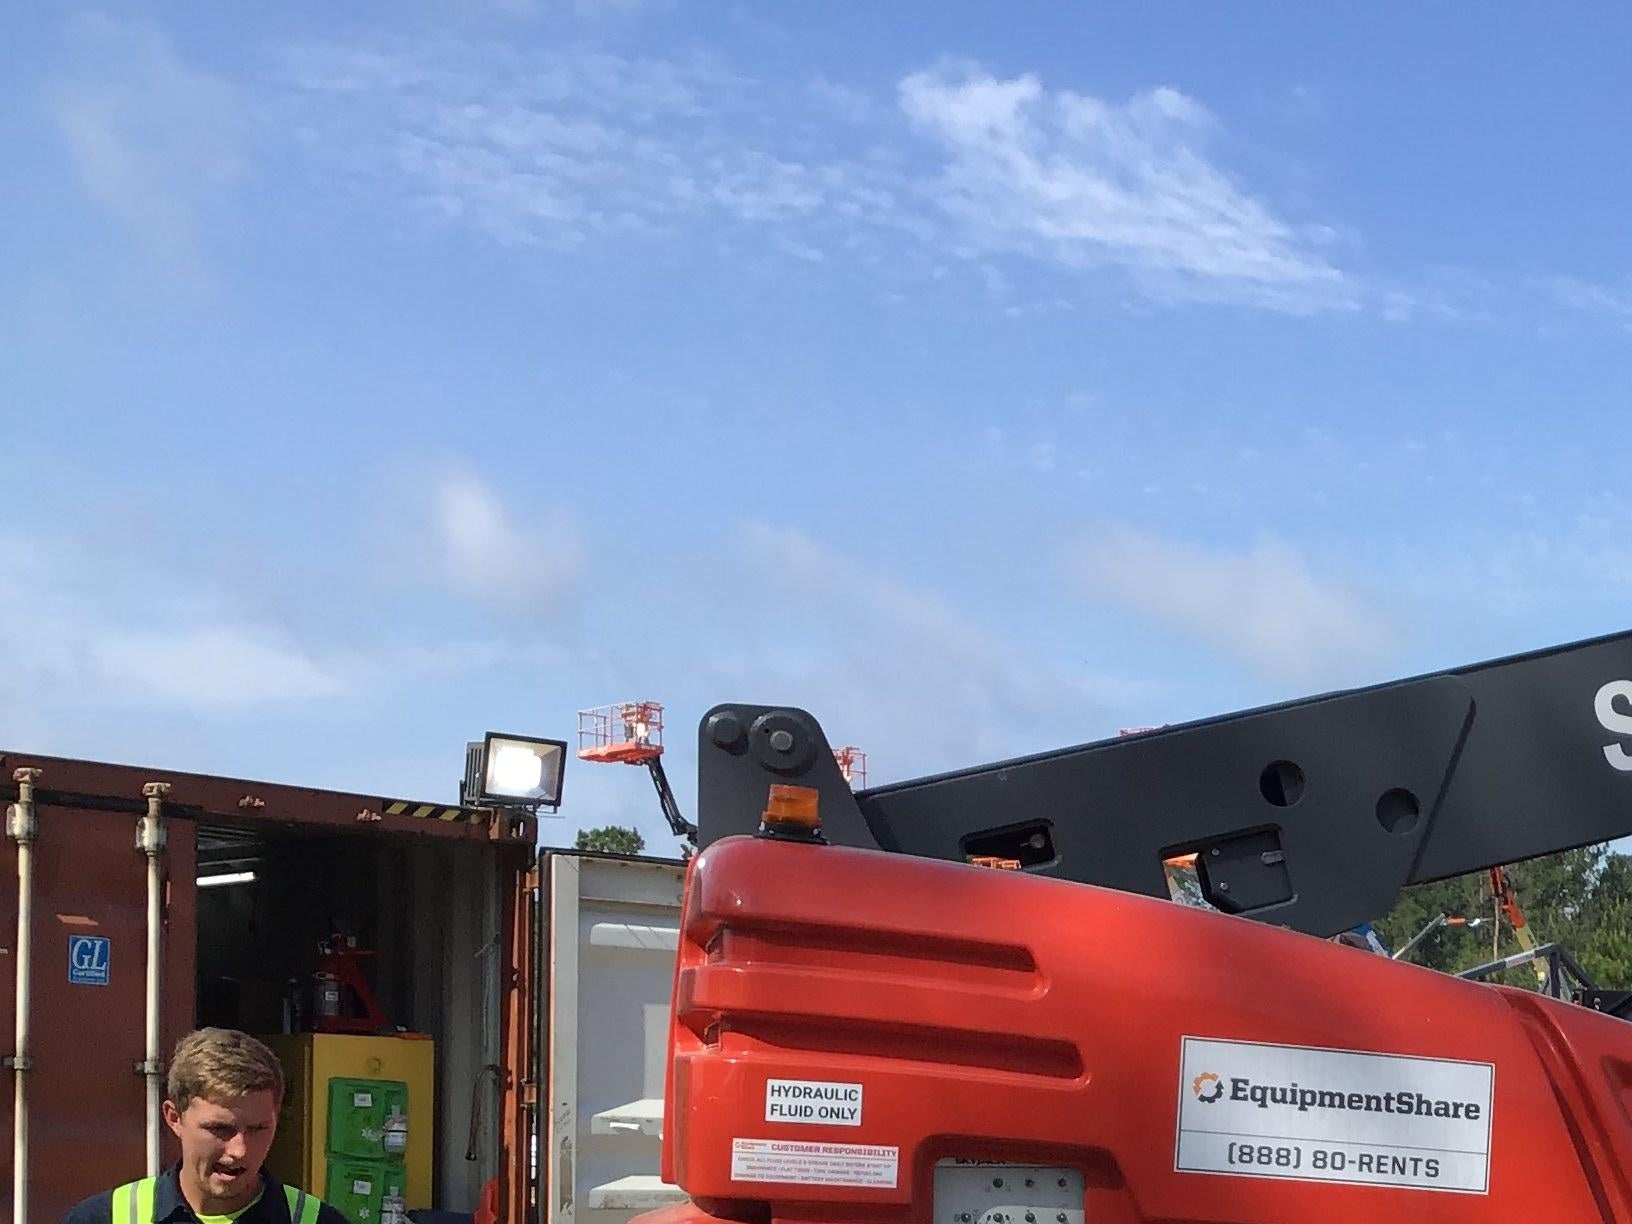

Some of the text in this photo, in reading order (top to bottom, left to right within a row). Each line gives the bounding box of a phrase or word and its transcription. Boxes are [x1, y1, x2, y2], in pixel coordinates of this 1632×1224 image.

[72, 939, 107, 970] GL
[771, 1084, 859, 1102] HYDRAULIC
[1230, 1078, 1481, 1120] EquipmentShare
[770, 1104, 857, 1120] FLUID ONLY
[771, 1143, 820, 1154] CUSTOMER
[822, 1146, 896, 1158] RESPONSIBILITY
[1228, 1142, 1440, 1178] (888) 80-RENTS
